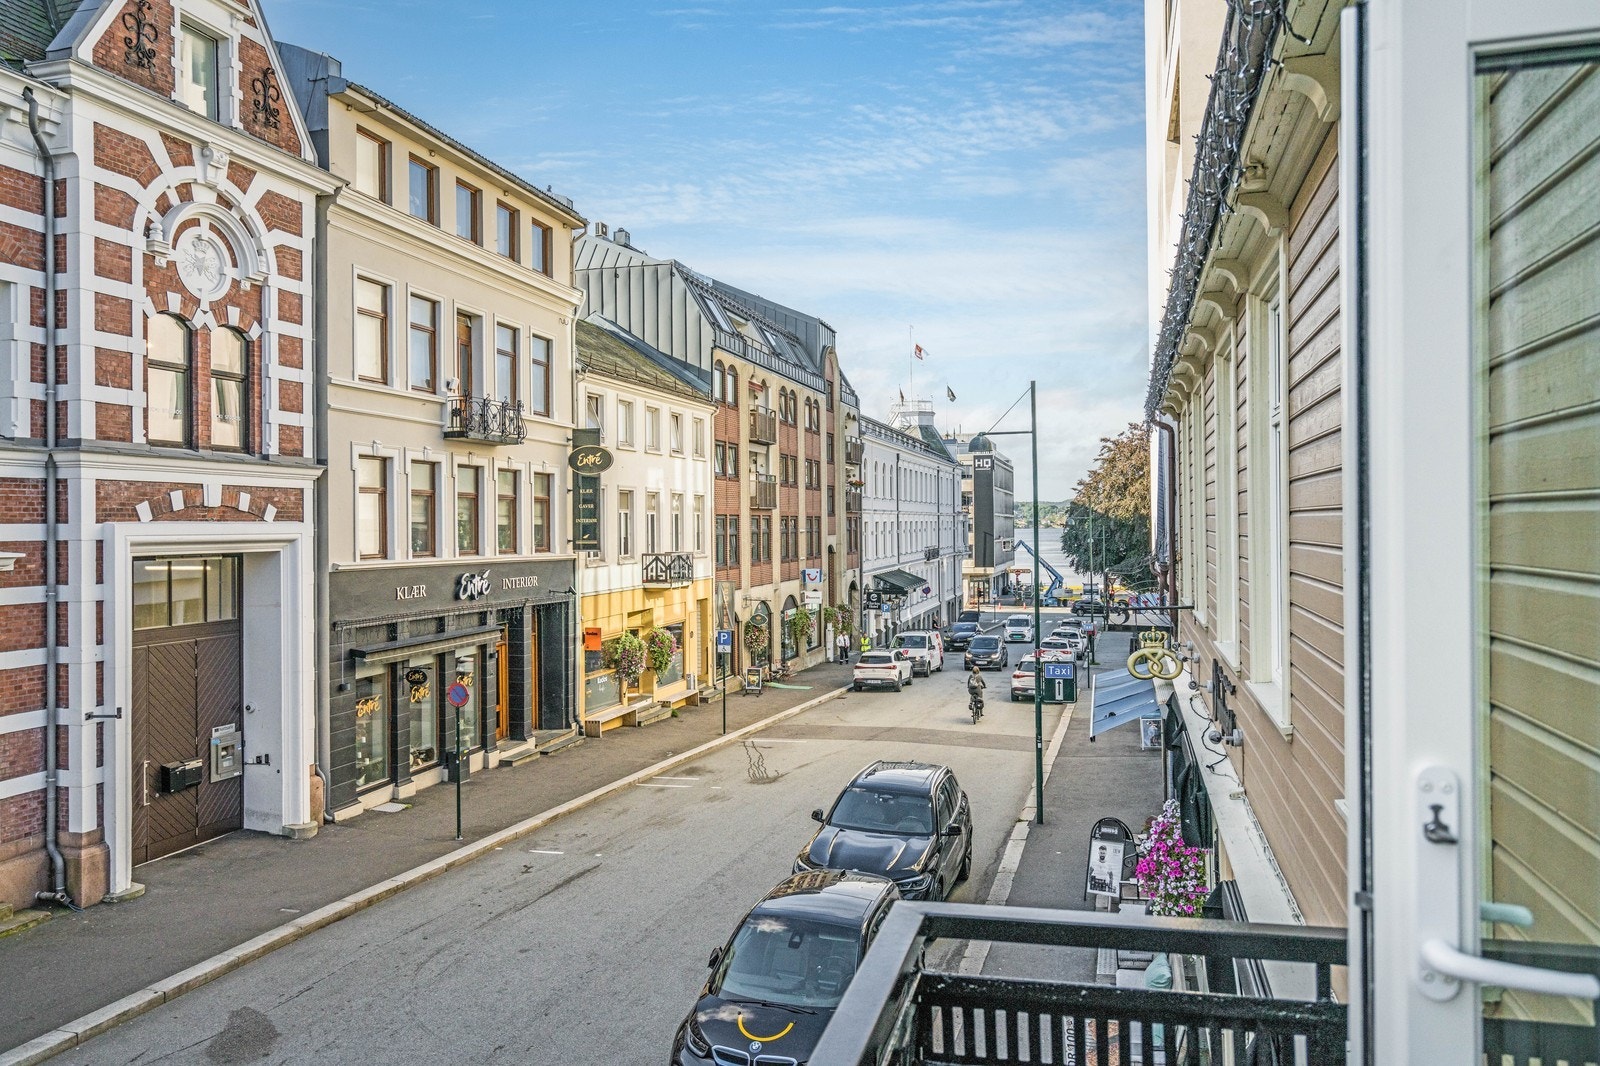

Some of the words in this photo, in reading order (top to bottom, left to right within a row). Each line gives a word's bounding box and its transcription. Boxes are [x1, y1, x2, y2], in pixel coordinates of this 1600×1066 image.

[577, 452, 602, 467] Entré
[396, 584, 426, 600] KLÆR
[458, 569, 491, 600] Entré
[502, 575, 538, 589] INTERIØR
[721, 632, 728, 643] P
[408, 672, 425, 682] Entré
[1048, 666, 1070, 675] Taxi
[411, 683, 431, 703] Entré
[356, 695, 380, 717] Entré
